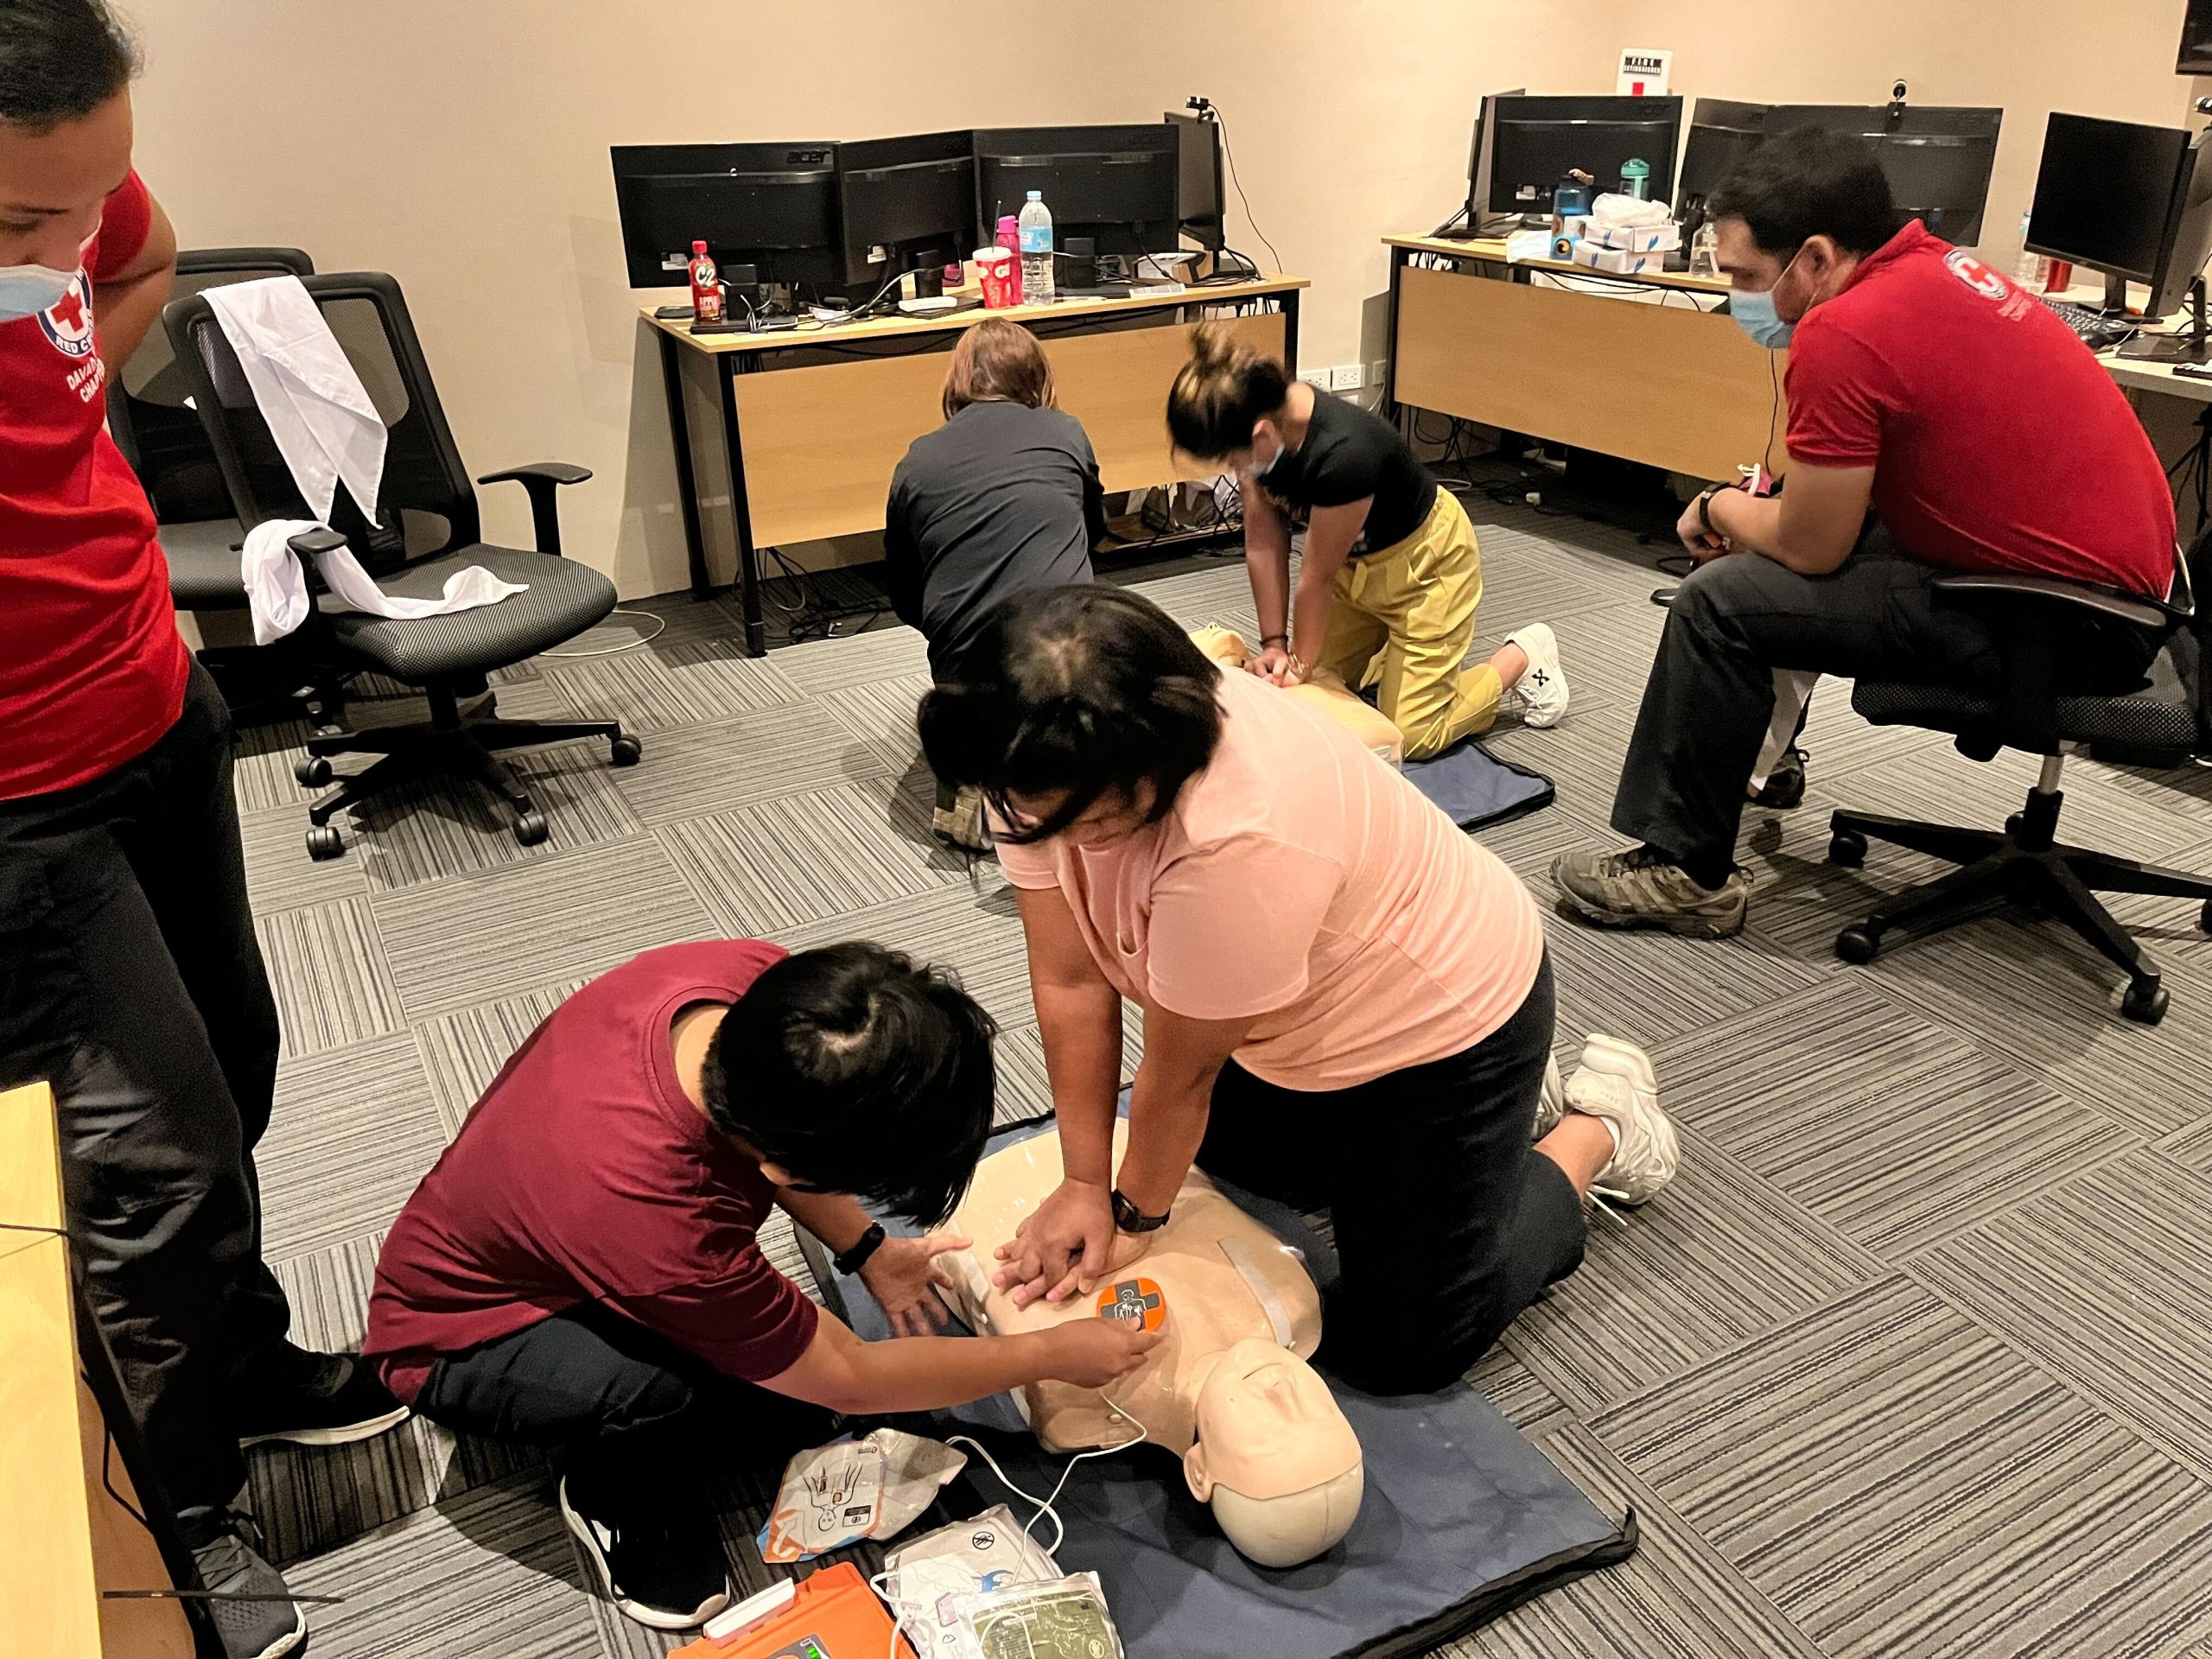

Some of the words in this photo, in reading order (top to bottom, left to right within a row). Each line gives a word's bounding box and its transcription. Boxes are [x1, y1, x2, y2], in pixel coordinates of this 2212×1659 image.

[787, 150, 830, 164] acer
[696, 266, 715, 287] C2
[55, 334, 78, 353] RED
